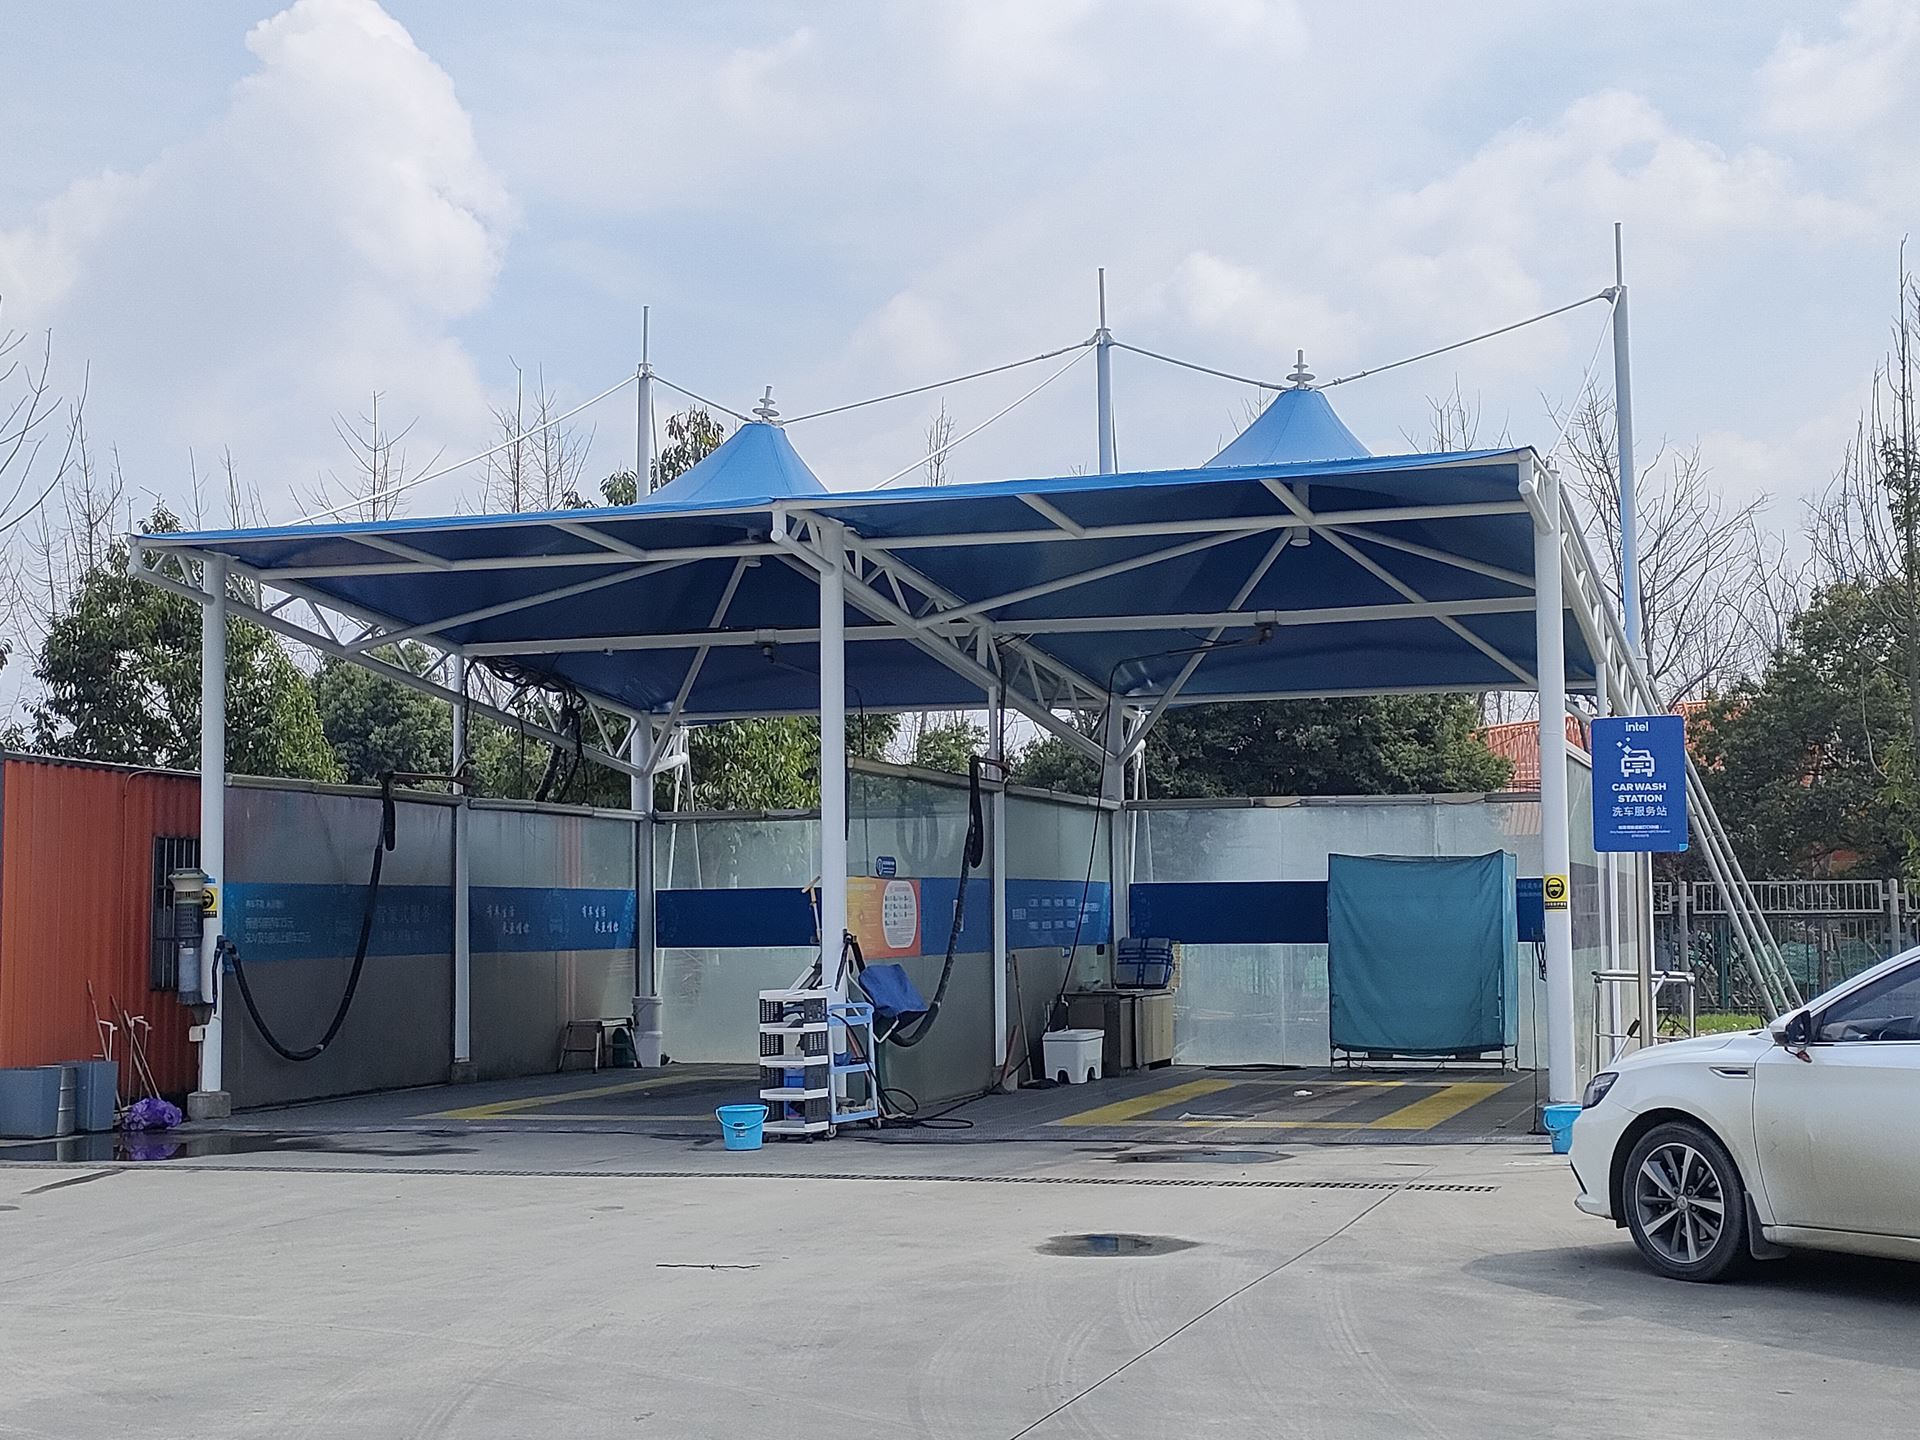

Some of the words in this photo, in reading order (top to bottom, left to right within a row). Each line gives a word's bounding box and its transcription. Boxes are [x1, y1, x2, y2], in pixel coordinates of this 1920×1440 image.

[1625, 721, 1649, 732] intel
[1611, 783, 1634, 792] CAR
[1634, 782, 1667, 791] WASH
[1617, 794, 1663, 803] STATION
[1612, 806, 1668, 817] 洗车服务站
